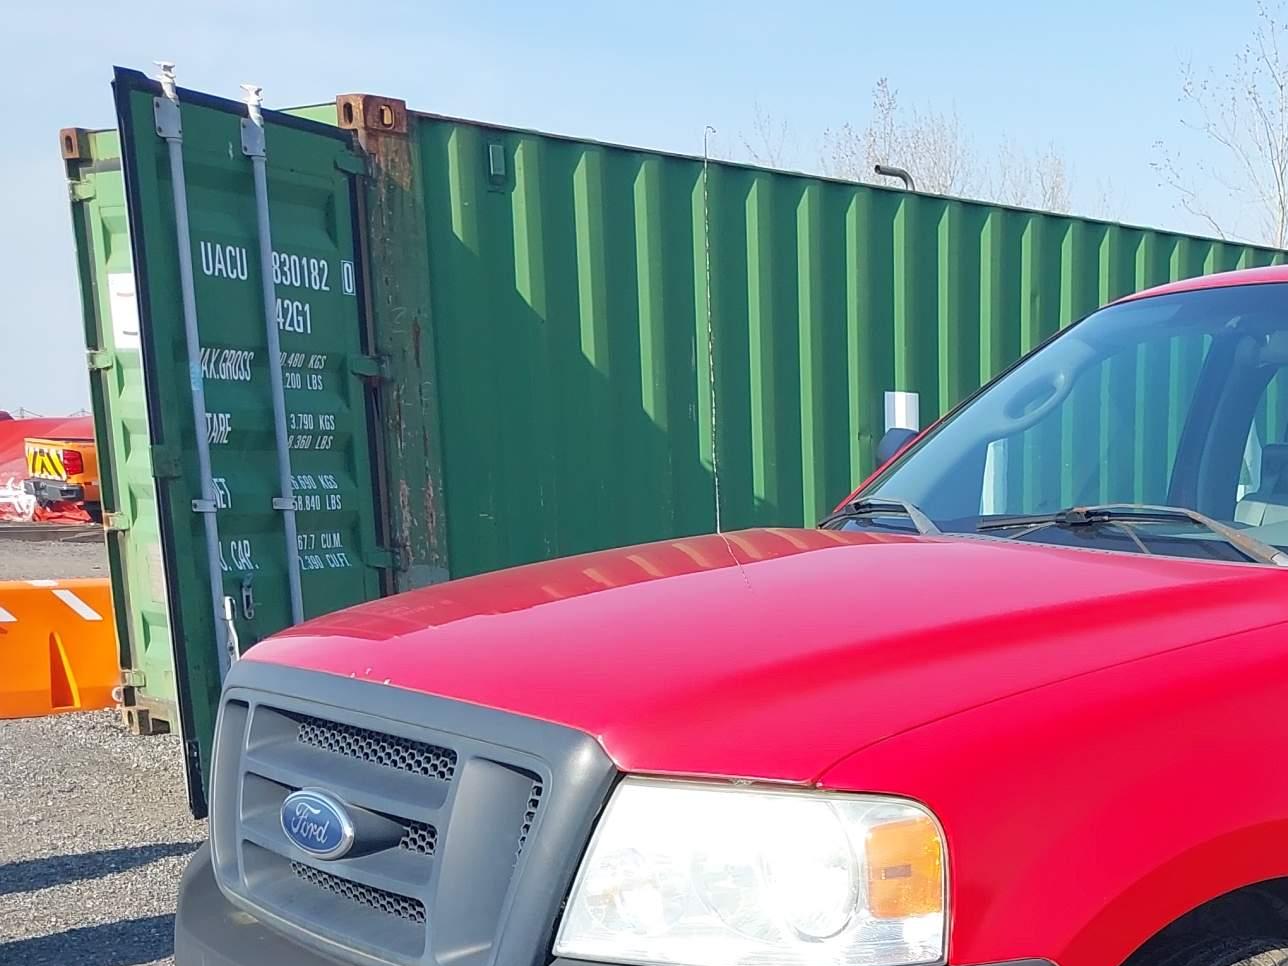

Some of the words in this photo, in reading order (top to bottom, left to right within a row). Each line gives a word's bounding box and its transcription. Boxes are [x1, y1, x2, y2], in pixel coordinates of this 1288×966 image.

[201, 241, 247, 280] UACU
[272, 251, 329, 291] 830182
[343, 263, 353, 293] 0
[275, 298, 311, 334] 42G1
[308, 355, 326, 369] KGS
[307, 374, 323, 390] LBS
[205, 412, 231, 444] TARE
[290, 413, 314, 430] 3.790
[319, 414, 335, 431] KGS
[315, 435, 334, 449] LBS
[318, 475, 338, 489] KGS
[326, 495, 341, 510] LBS
[297, 534, 315, 550] 67.7
[230, 540, 259, 570] CAP.
[291, 802, 330, 844] Ford
